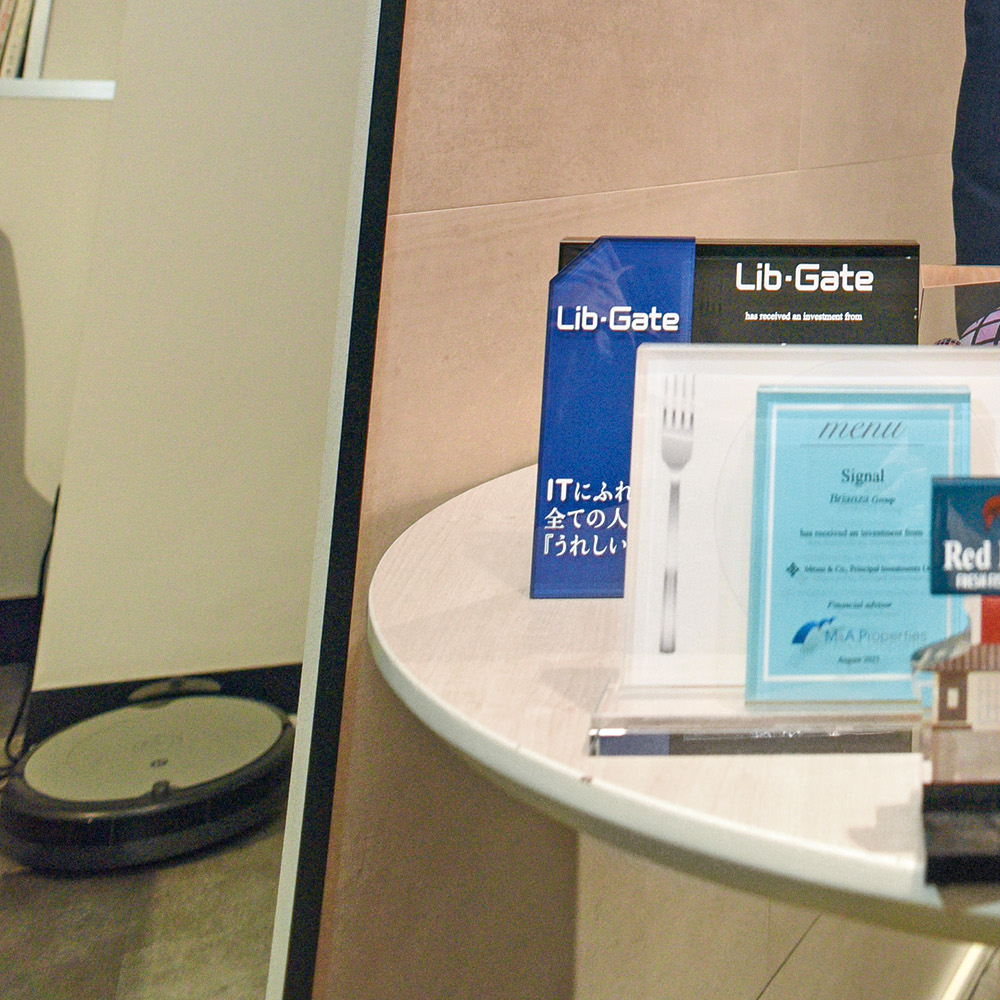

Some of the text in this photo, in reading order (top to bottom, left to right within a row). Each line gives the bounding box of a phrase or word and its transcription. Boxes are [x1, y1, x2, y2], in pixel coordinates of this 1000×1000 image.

[744, 311, 863, 321] has received an investment from
[818, 420, 907, 440] menu
[840, 468, 885, 487] Signal
[543, 506, 629, 530] 全ての人
[943, 539, 992, 571] Red
